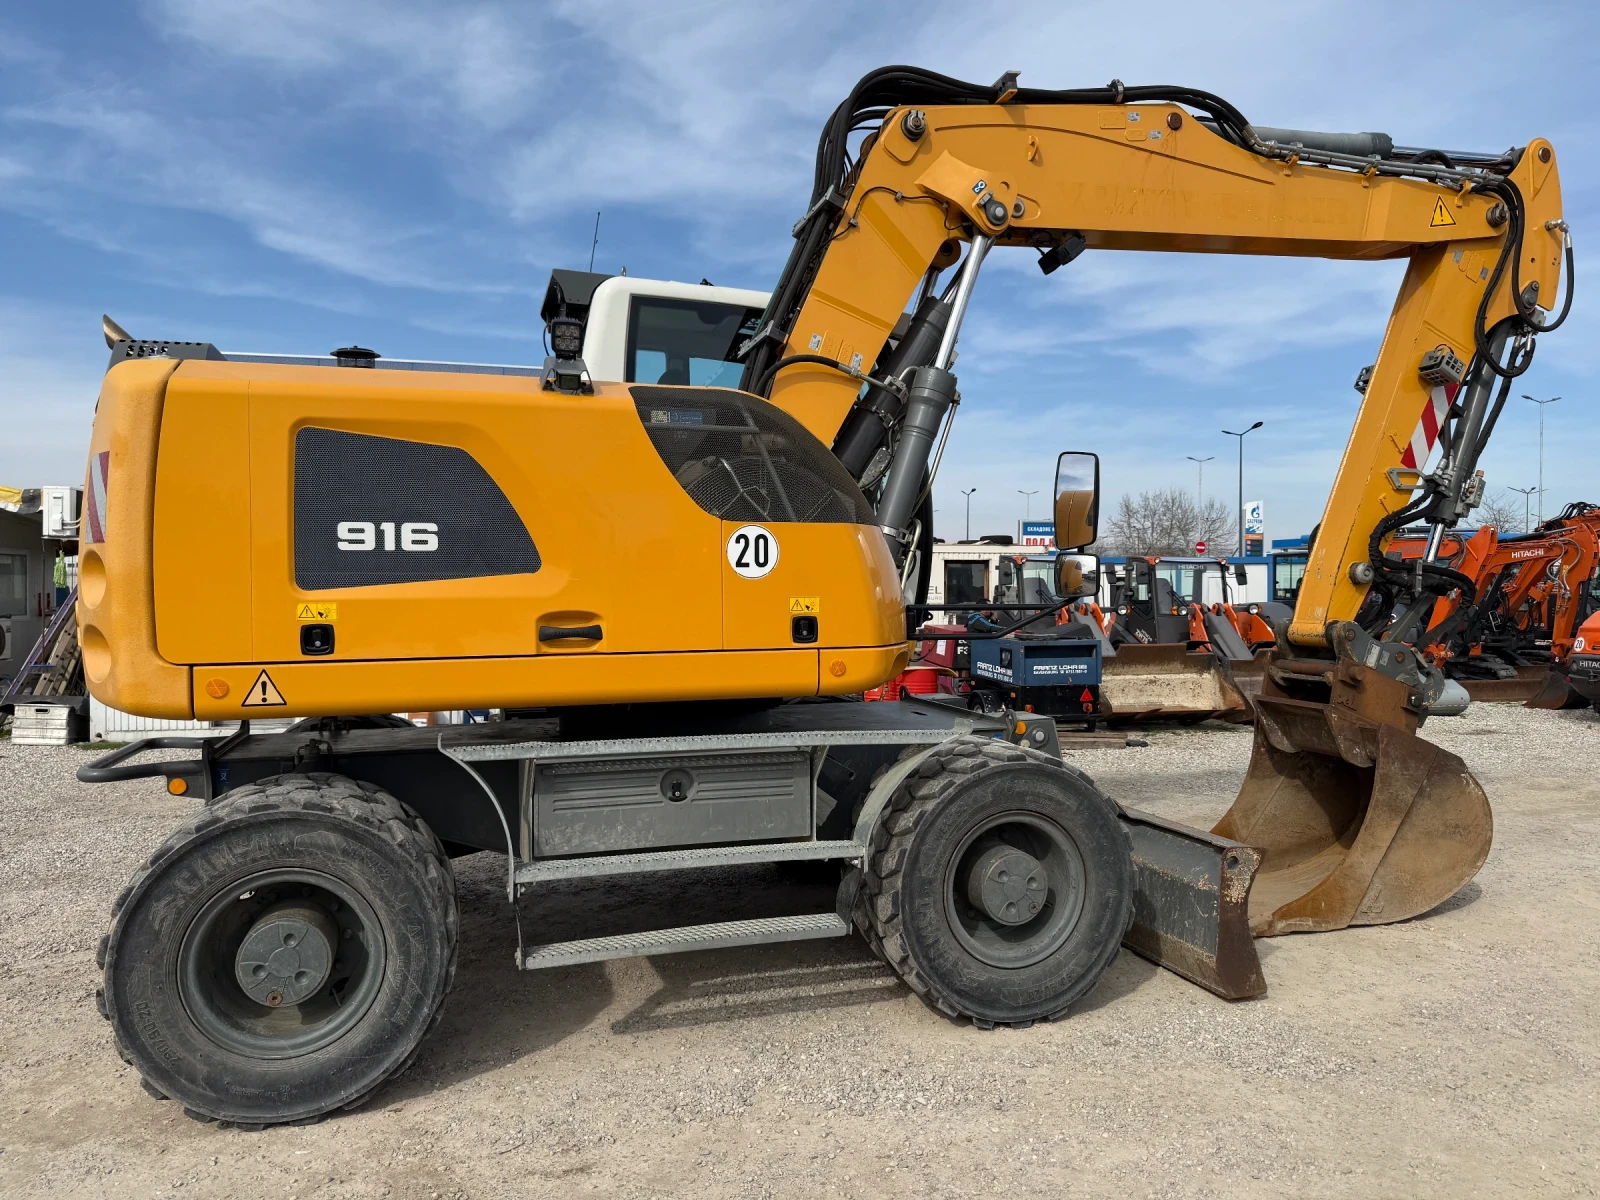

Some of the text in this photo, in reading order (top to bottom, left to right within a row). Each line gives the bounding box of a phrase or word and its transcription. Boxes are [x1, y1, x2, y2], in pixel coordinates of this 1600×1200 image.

[337, 521, 439, 551] 916
[735, 533, 769, 568] 20
[1511, 549, 1544, 559] HITACHI
[1574, 639, 1583, 650] 20
